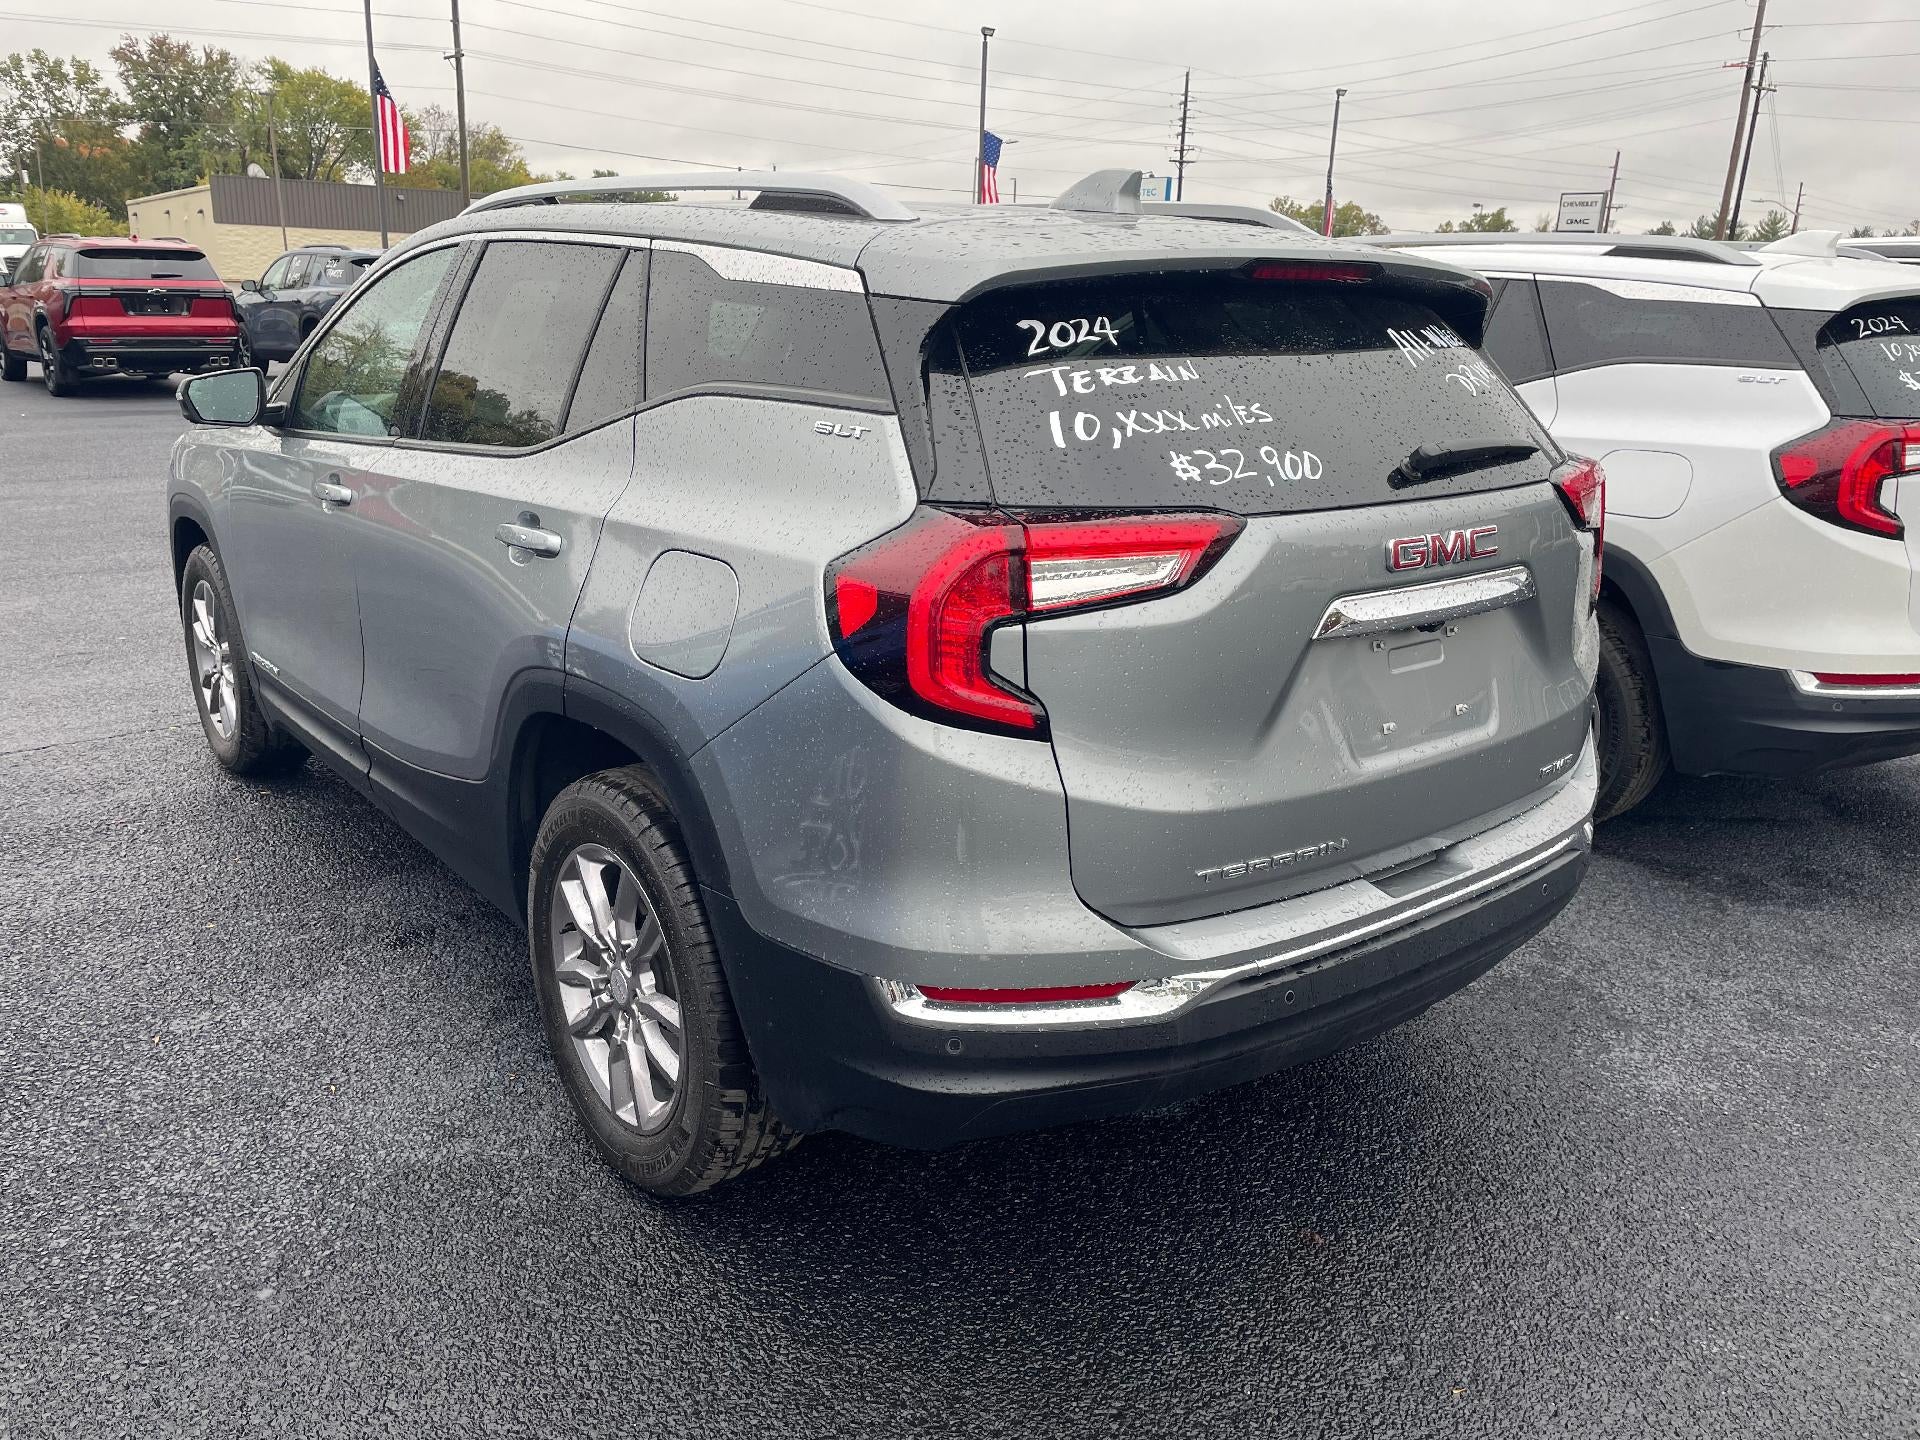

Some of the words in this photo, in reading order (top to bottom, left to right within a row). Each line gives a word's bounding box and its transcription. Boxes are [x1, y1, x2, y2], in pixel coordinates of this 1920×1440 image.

[1562, 200, 1599, 208] CHEVROLET
[1016, 316, 1120, 357] 2024
[1850, 315, 1911, 339] 2024
[1736, 375, 1788, 385] SLT
[814, 420, 872, 440] SLT
[1169, 446, 1323, 487] $32,900
[1388, 524, 1499, 572] GMC
[1195, 838, 1350, 883] TERRAIN
